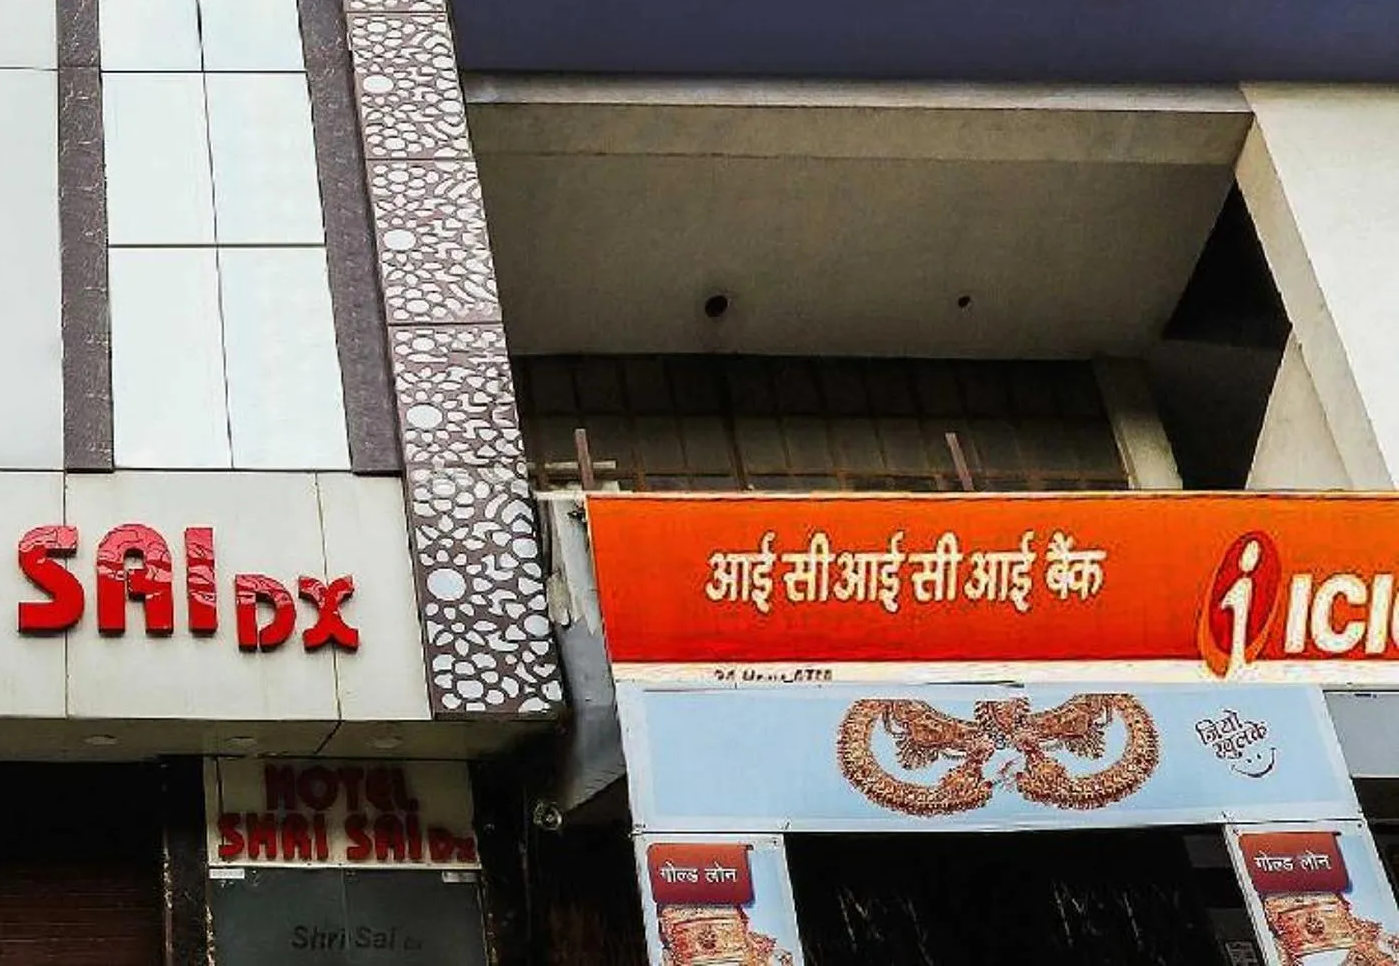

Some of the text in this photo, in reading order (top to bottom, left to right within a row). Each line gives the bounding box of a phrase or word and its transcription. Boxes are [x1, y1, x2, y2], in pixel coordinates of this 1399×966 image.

[17, 522, 221, 638] SAI
[234, 571, 363, 654] DX
[1045, 531, 1107, 600] बैंक
[1283, 572, 1399, 655] ICI
[264, 764, 420, 812] HOTEL
[217, 812, 330, 862] SHRI
[343, 811, 424, 862] SAI
[291, 923, 346, 952] Shri
